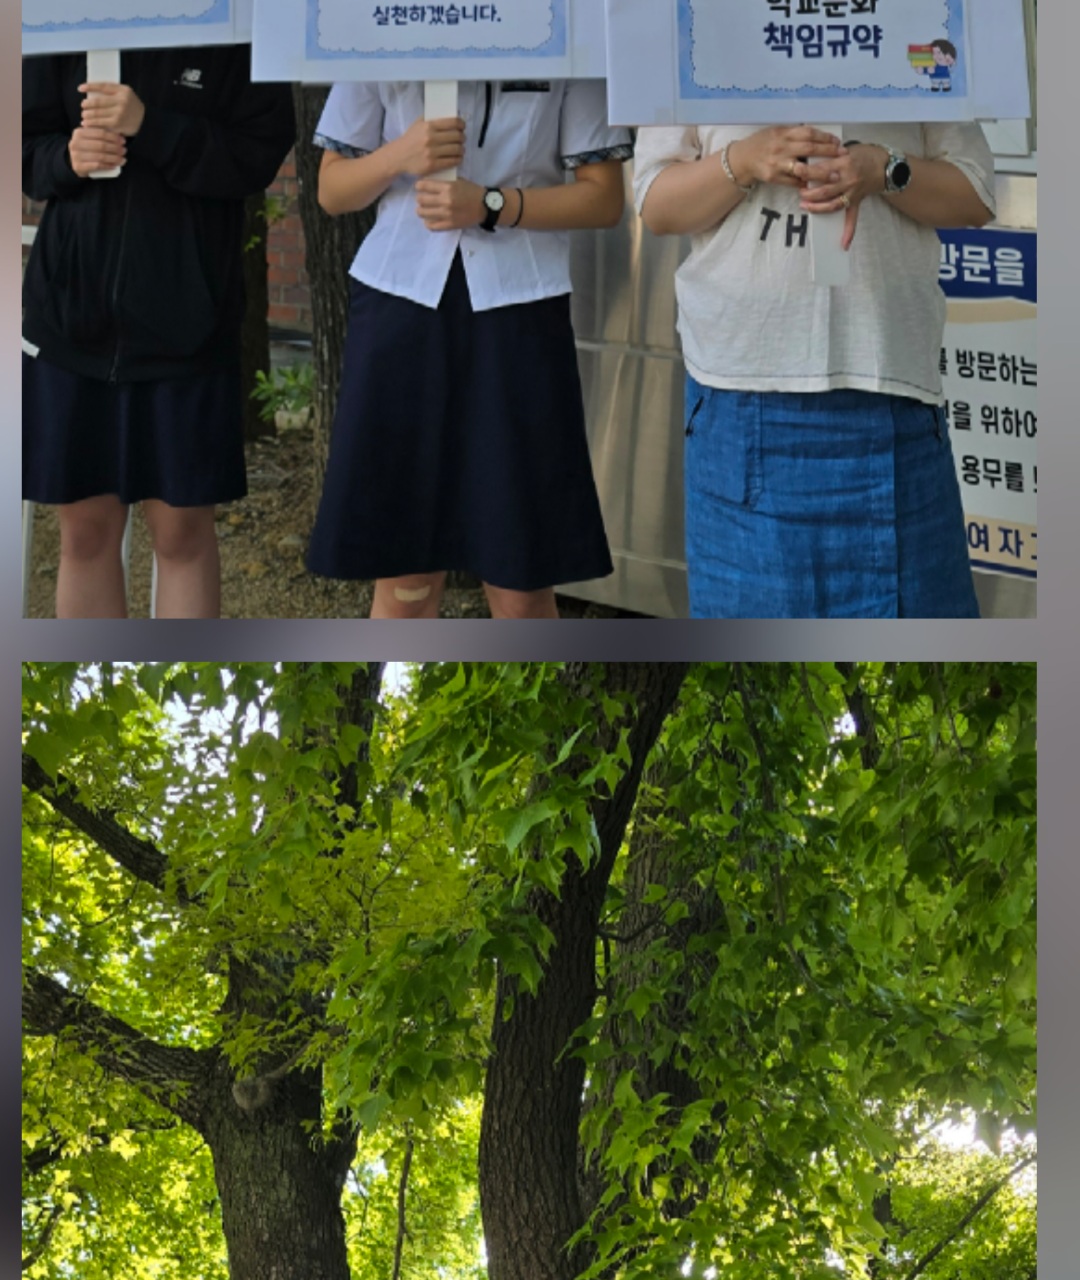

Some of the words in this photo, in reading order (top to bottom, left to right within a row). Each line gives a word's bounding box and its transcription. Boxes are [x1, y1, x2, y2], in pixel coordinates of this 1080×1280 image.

[372, 4, 502, 26] 실천하겠습니다.
[762, 21, 884, 58] 책임규약
[961, 454, 1025, 493] 용무를
